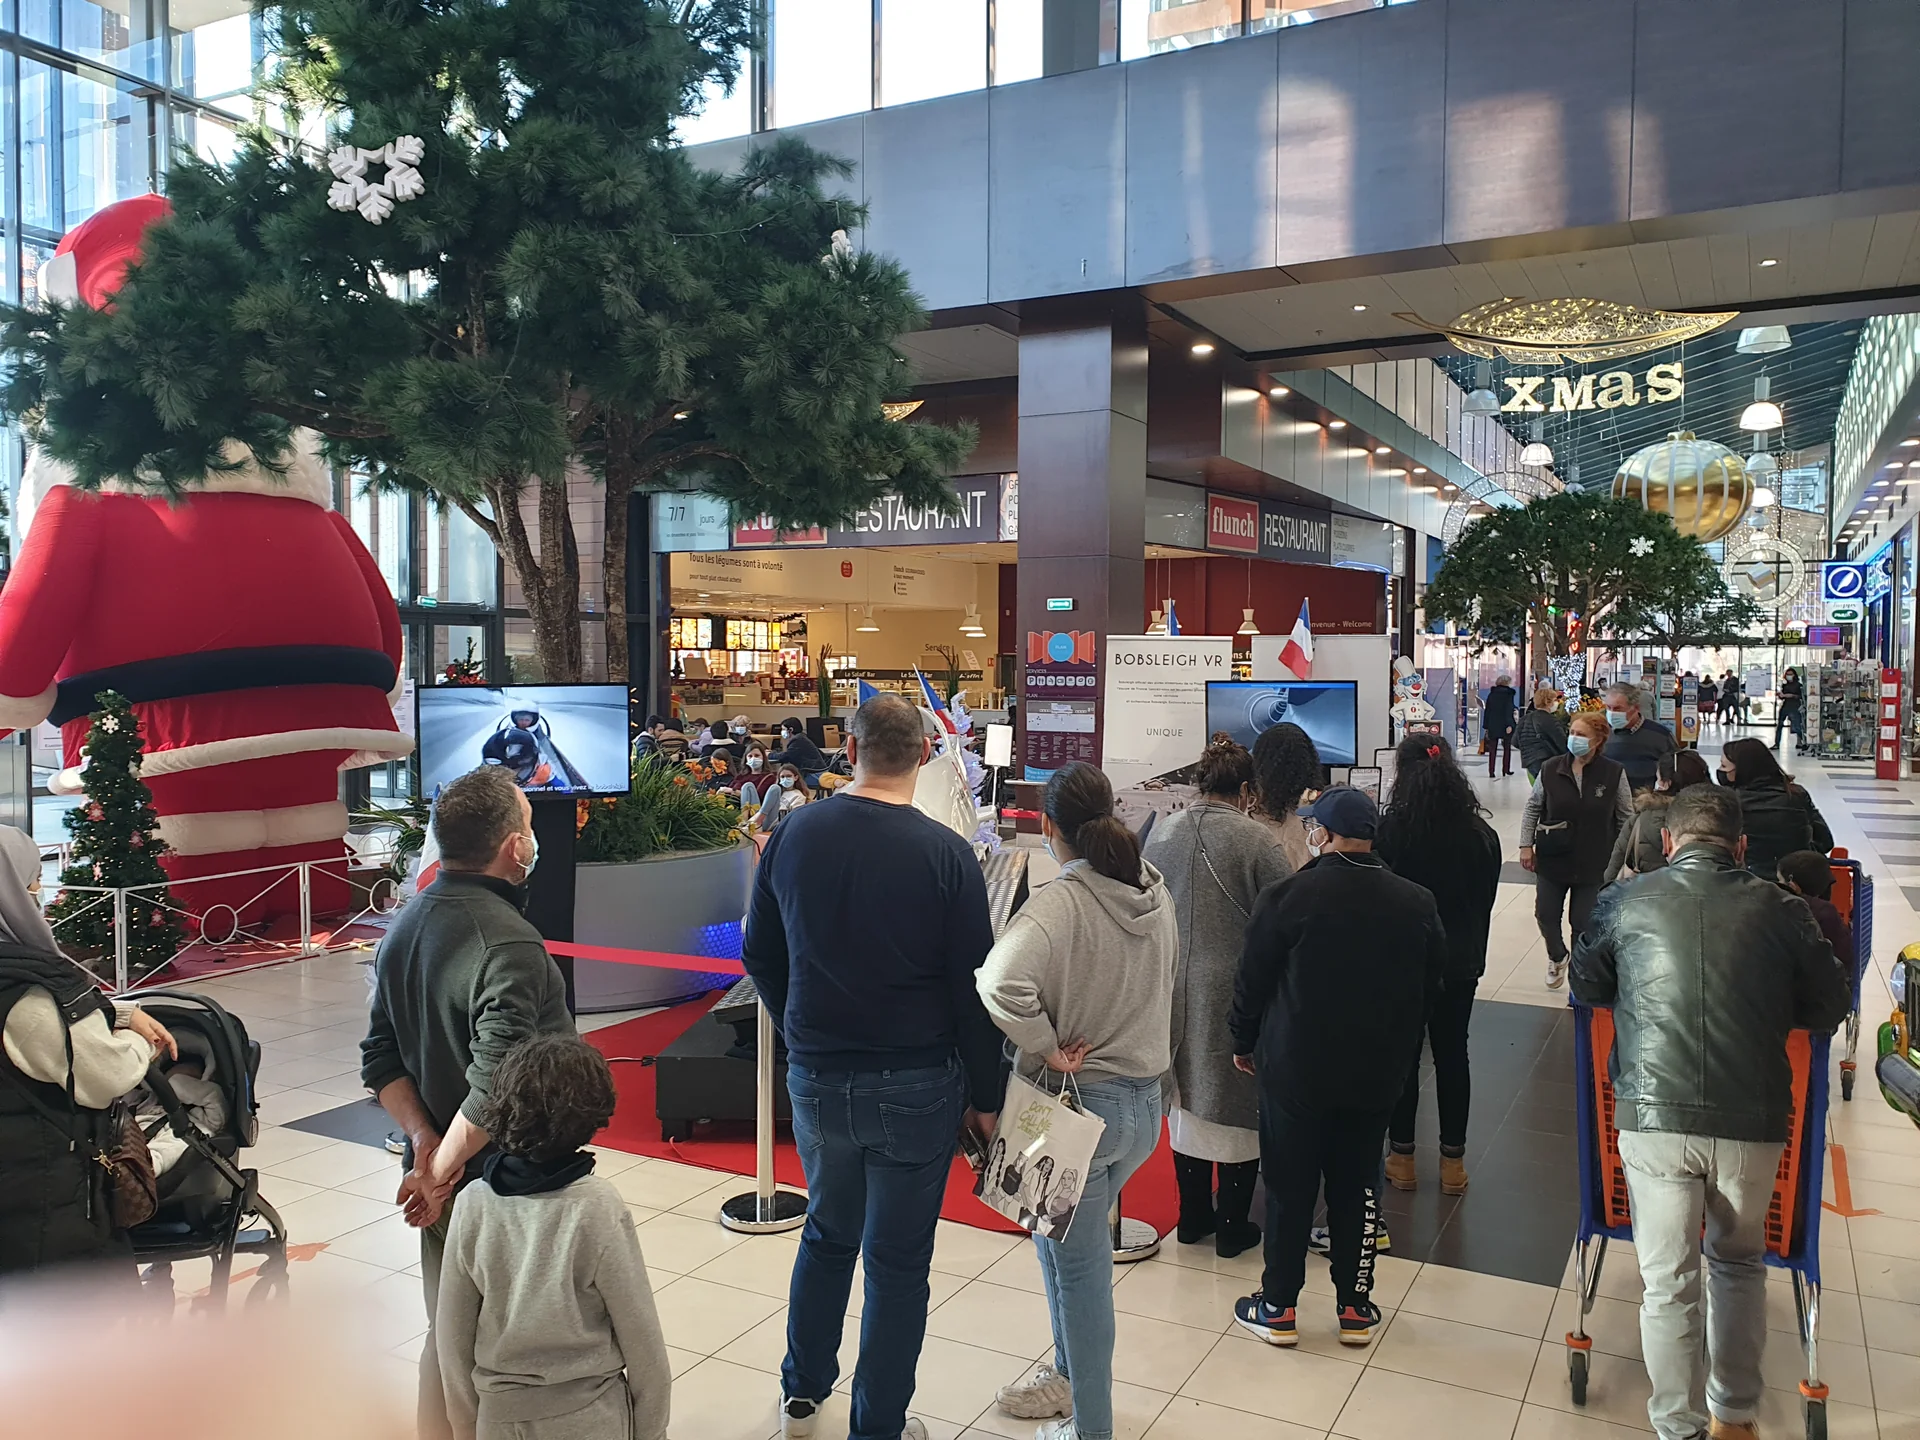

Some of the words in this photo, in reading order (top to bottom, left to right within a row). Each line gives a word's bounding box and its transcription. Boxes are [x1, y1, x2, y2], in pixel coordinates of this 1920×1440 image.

[668, 506, 685, 521] 7/7
[699, 514, 715, 526] jours
[1212, 506, 1255, 538] flunch
[1264, 513, 1327, 553] RESTAURANT
[689, 552, 704, 562] Tous
[705, 554, 714, 564] les
[716, 554, 742, 568] légumes
[742, 558, 756, 568] sont
[757, 560, 760, 568] à
[762, 560, 783, 572] volonté
[1114, 653, 1197, 666] BOBSLEIGH
[1204, 654, 1222, 667] VR
[1146, 728, 1184, 737] UNIQUE
[1354, 1188, 1376, 1293] SPORTSWEAR
